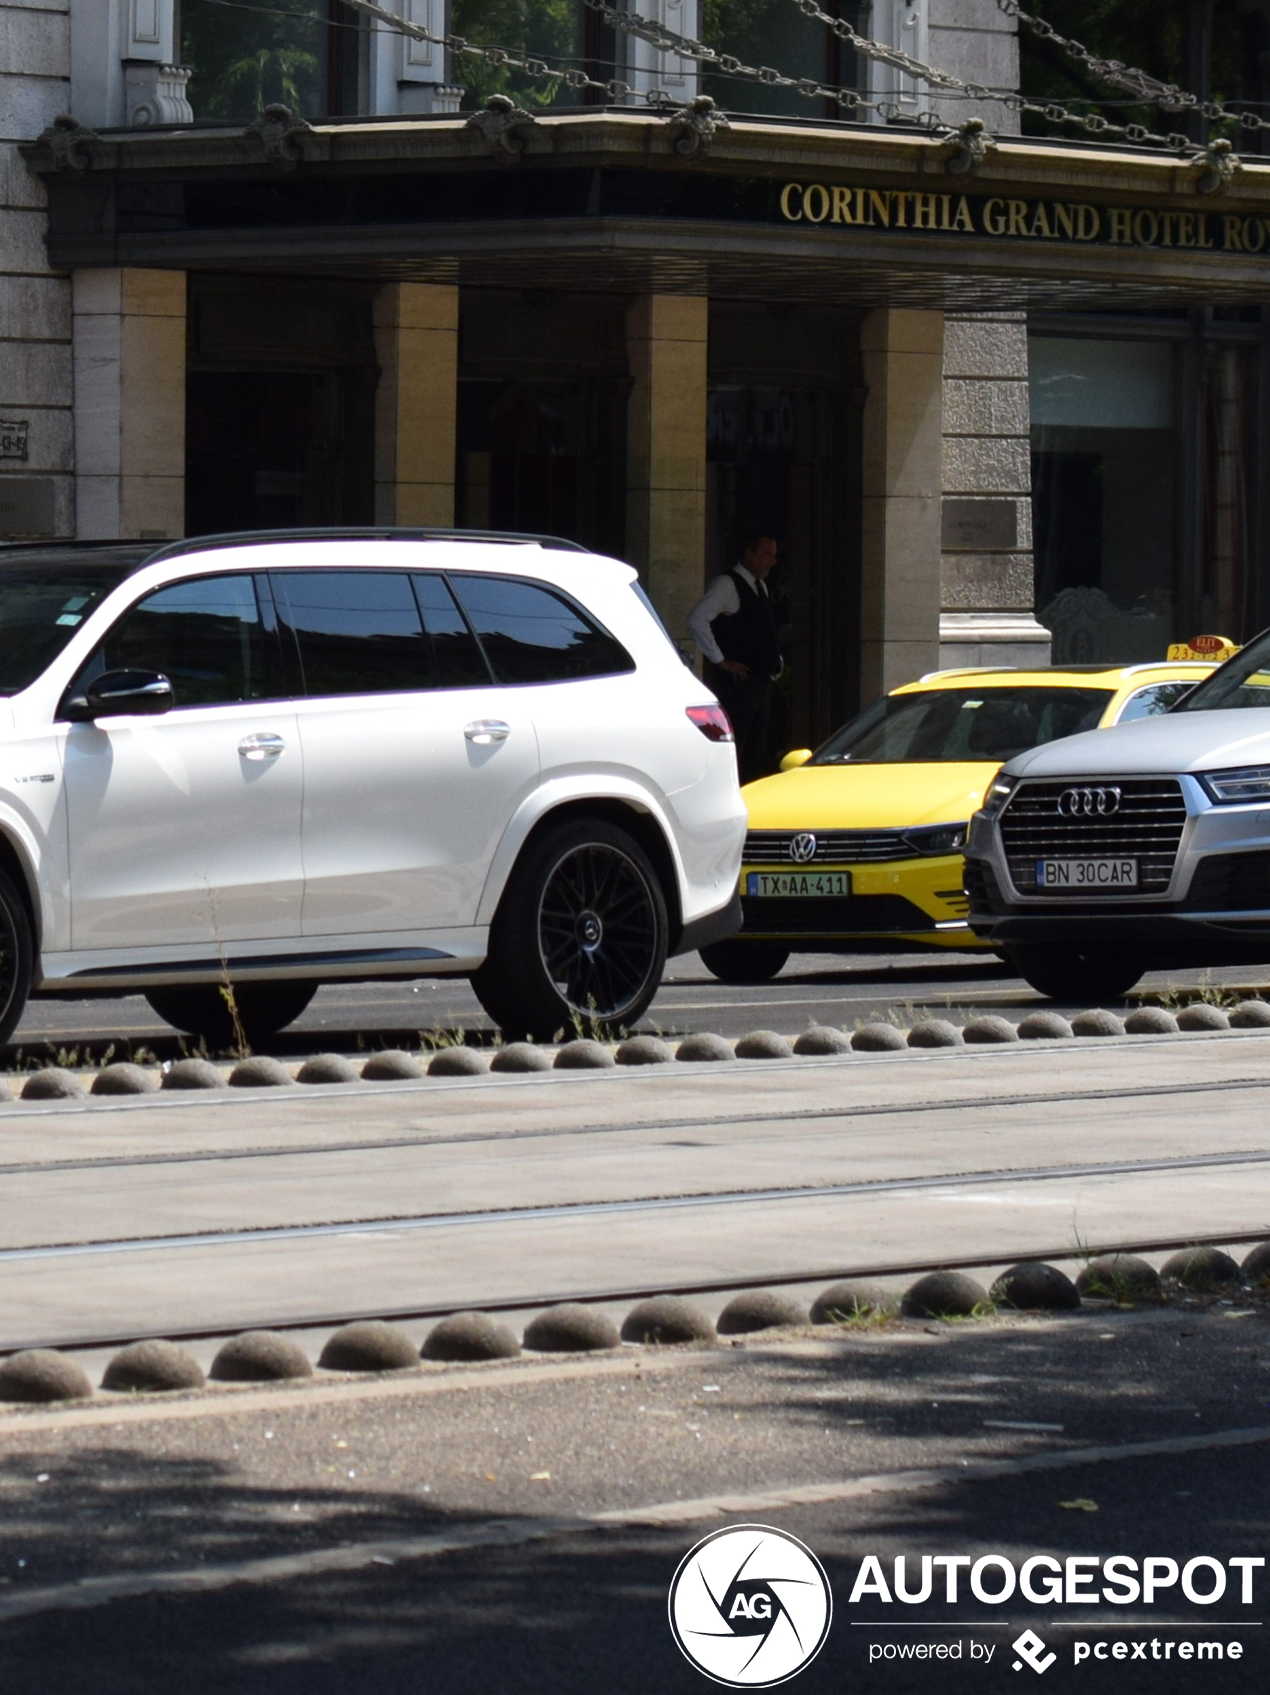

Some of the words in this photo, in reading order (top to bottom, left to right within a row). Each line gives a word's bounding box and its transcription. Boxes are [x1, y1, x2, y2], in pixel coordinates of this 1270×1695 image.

[780, 183, 975, 232] CORINTHIA
[983, 198, 1100, 240] GRAND
[1107, 208, 1213, 249] HOTEL
[1196, 638, 1215, 647] ELIT
[1045, 863, 1069, 884] BN
